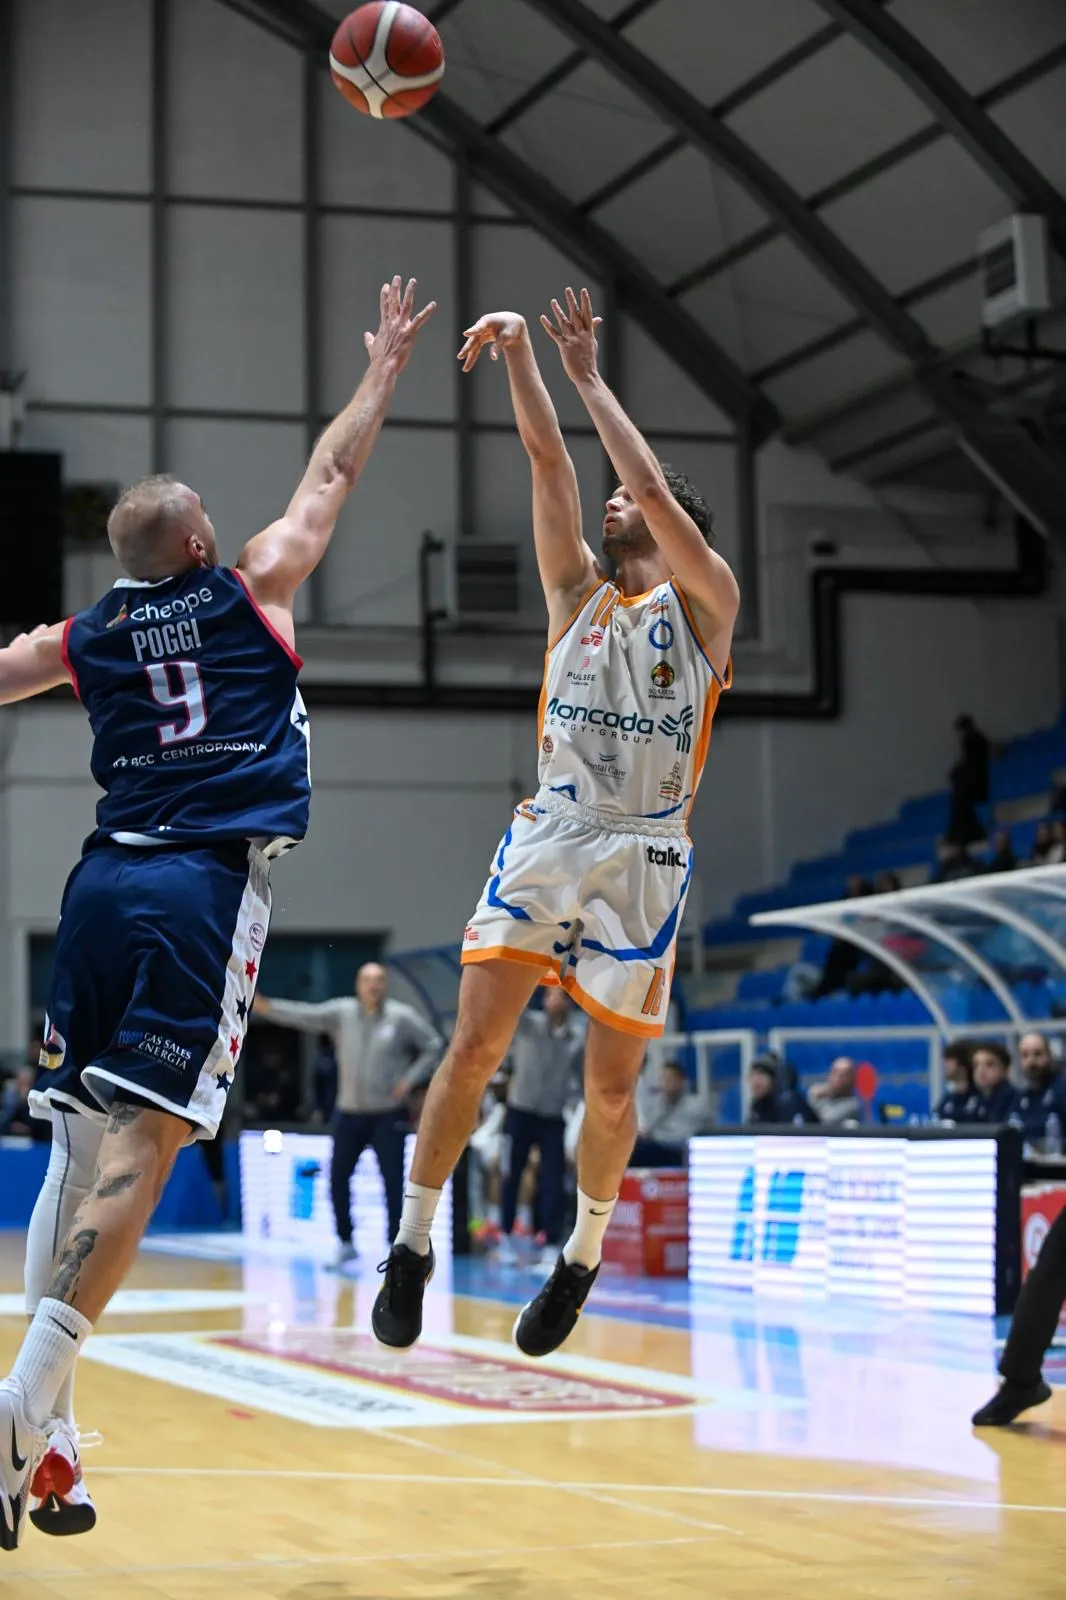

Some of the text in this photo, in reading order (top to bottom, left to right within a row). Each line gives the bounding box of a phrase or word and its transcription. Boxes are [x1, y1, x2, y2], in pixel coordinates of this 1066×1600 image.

[131, 618, 202, 662] POGGI
[567, 671, 597, 682] PULSEE
[144, 660, 208, 746] 9
[131, 742, 267, 767] BCC CENTROPADANA
[138, 1041, 187, 1070] ENERGIA
[144, 1032, 163, 1046] GAS
[163, 1038, 192, 1060] SALES
